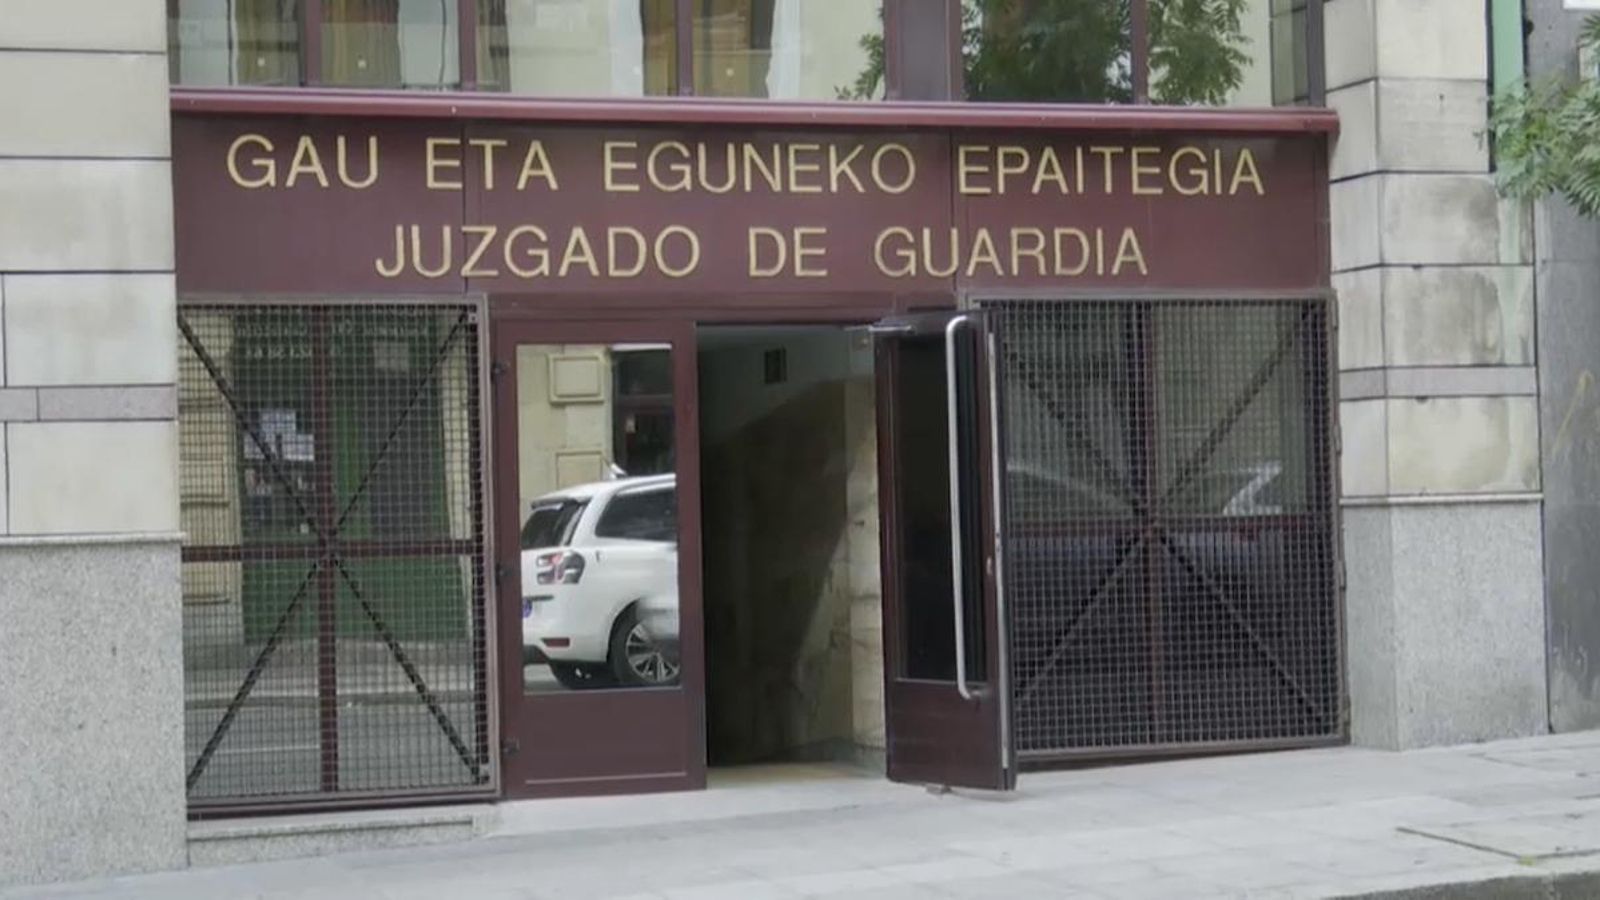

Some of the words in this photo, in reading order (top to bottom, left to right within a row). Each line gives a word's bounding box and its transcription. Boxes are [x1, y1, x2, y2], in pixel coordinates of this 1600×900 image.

[227, 134, 379, 188] GAU
[426, 138, 558, 190] ETA
[603, 141, 916, 193] EGUNEKO
[958, 146, 1265, 196] EPAITEGIA
[375, 225, 700, 278] JUZGADO
[748, 227, 828, 277] DE
[874, 227, 1148, 278] GUARDIA
